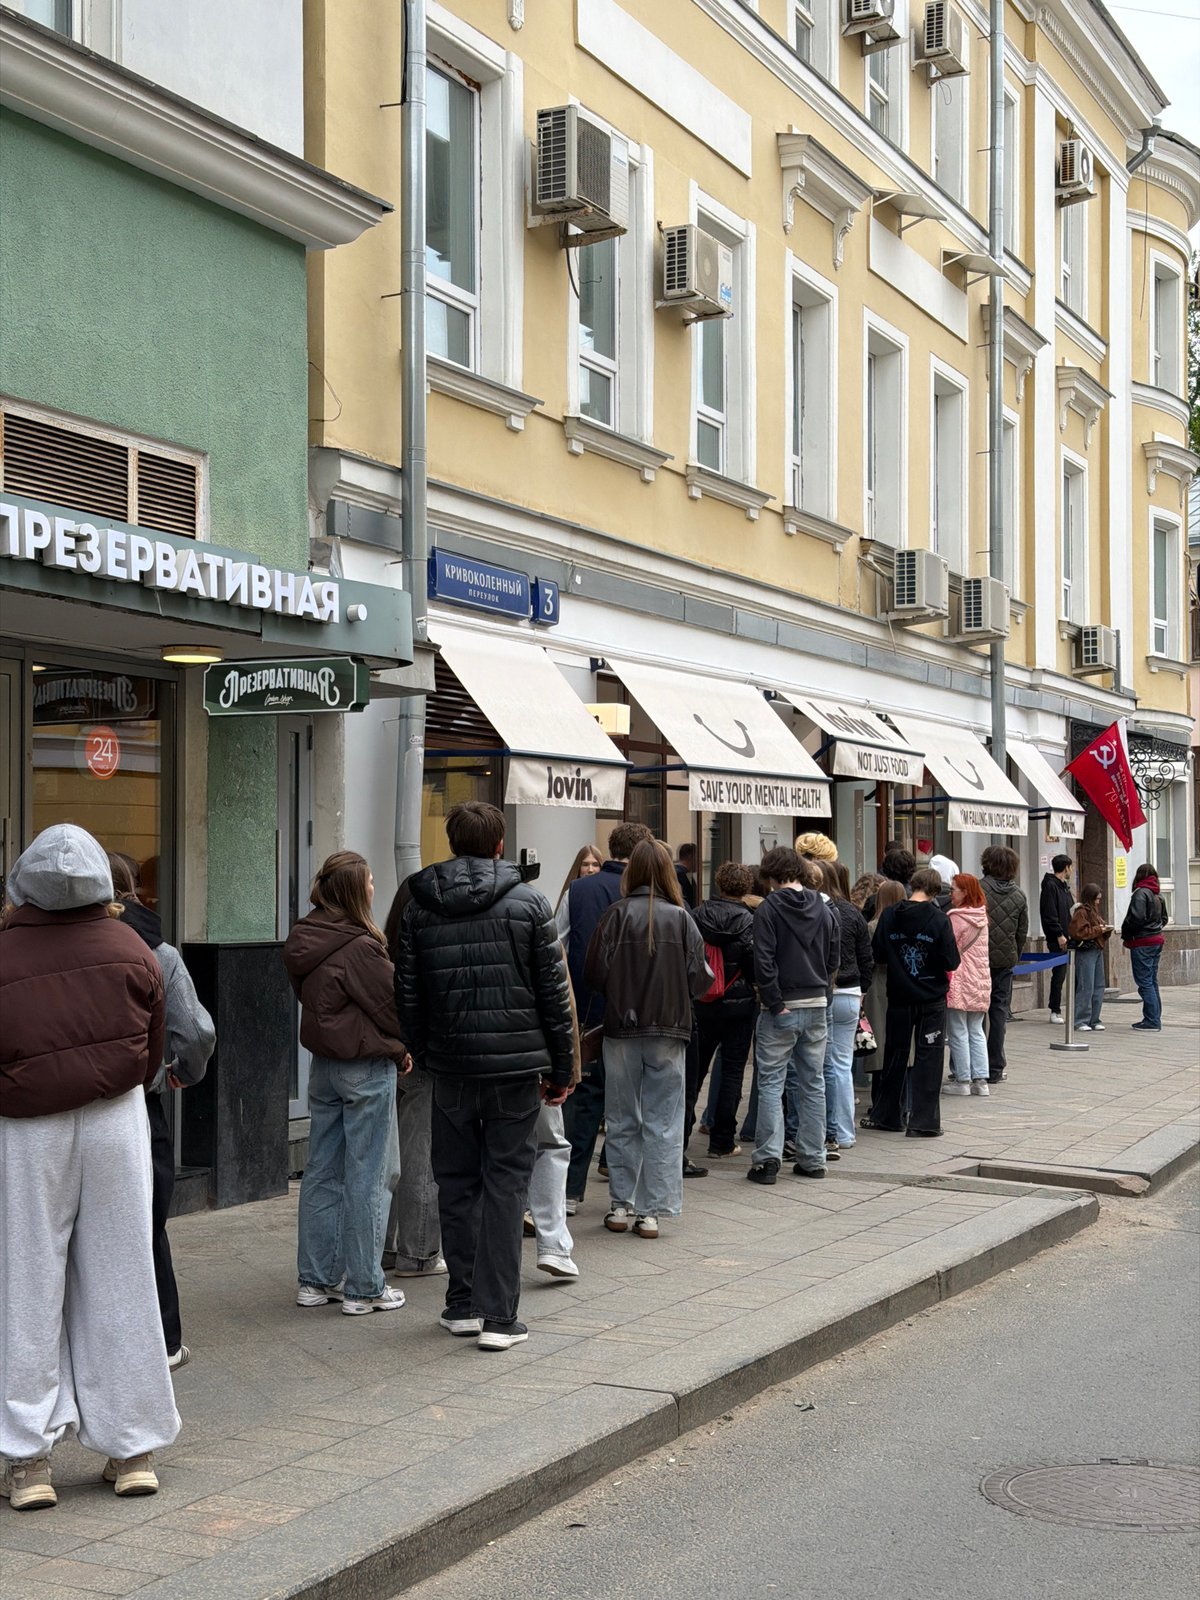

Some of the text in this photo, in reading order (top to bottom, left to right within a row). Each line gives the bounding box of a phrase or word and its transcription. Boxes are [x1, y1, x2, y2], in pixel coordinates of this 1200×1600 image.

[0, 503, 340, 624] ПРЕЗЕРВАТИВНАЯ
[445, 563, 522, 597] КРИВОКОЛЕННЫЙ
[468, 588, 500, 603] ПЕРЕУЛОК
[544, 588, 554, 616] 3
[93, 736, 113, 763] 24
[857, 751, 909, 777] NOT JUST FOOD
[699, 779, 821, 809] SAVE YOUR MENTAL HEALTH
[969, 810, 987, 827] FALLING
[988, 811, 994, 828] IN
[994, 811, 1006, 828] LOVE
[1006, 813, 1020, 830] AGAIN
